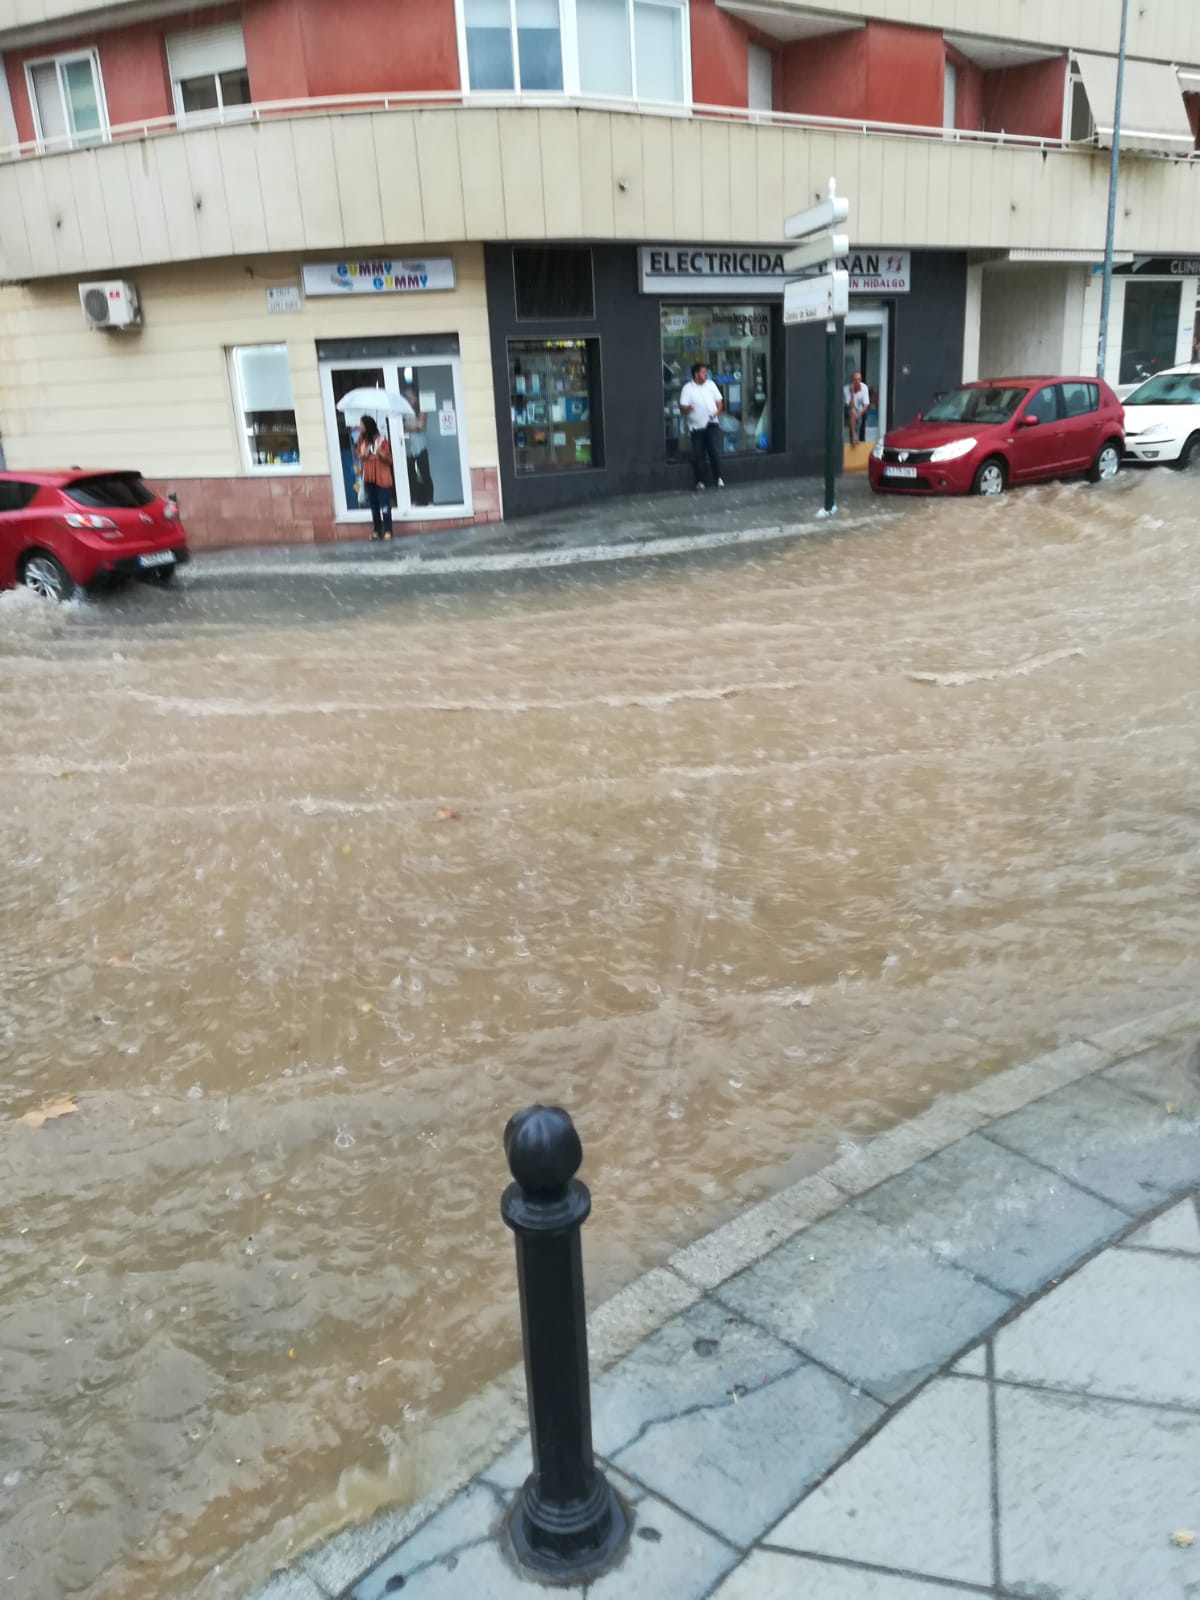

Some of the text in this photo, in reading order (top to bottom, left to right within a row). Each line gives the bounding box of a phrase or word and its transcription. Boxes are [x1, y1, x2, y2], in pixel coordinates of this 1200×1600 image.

[337, 260, 393, 277] GUMMY
[649, 251, 785, 273] ELECTRICIDA
[1169, 260, 1200, 274] CLINI
[372, 274, 428, 290] GUMMY
[863, 278, 905, 288] HIDALGO
